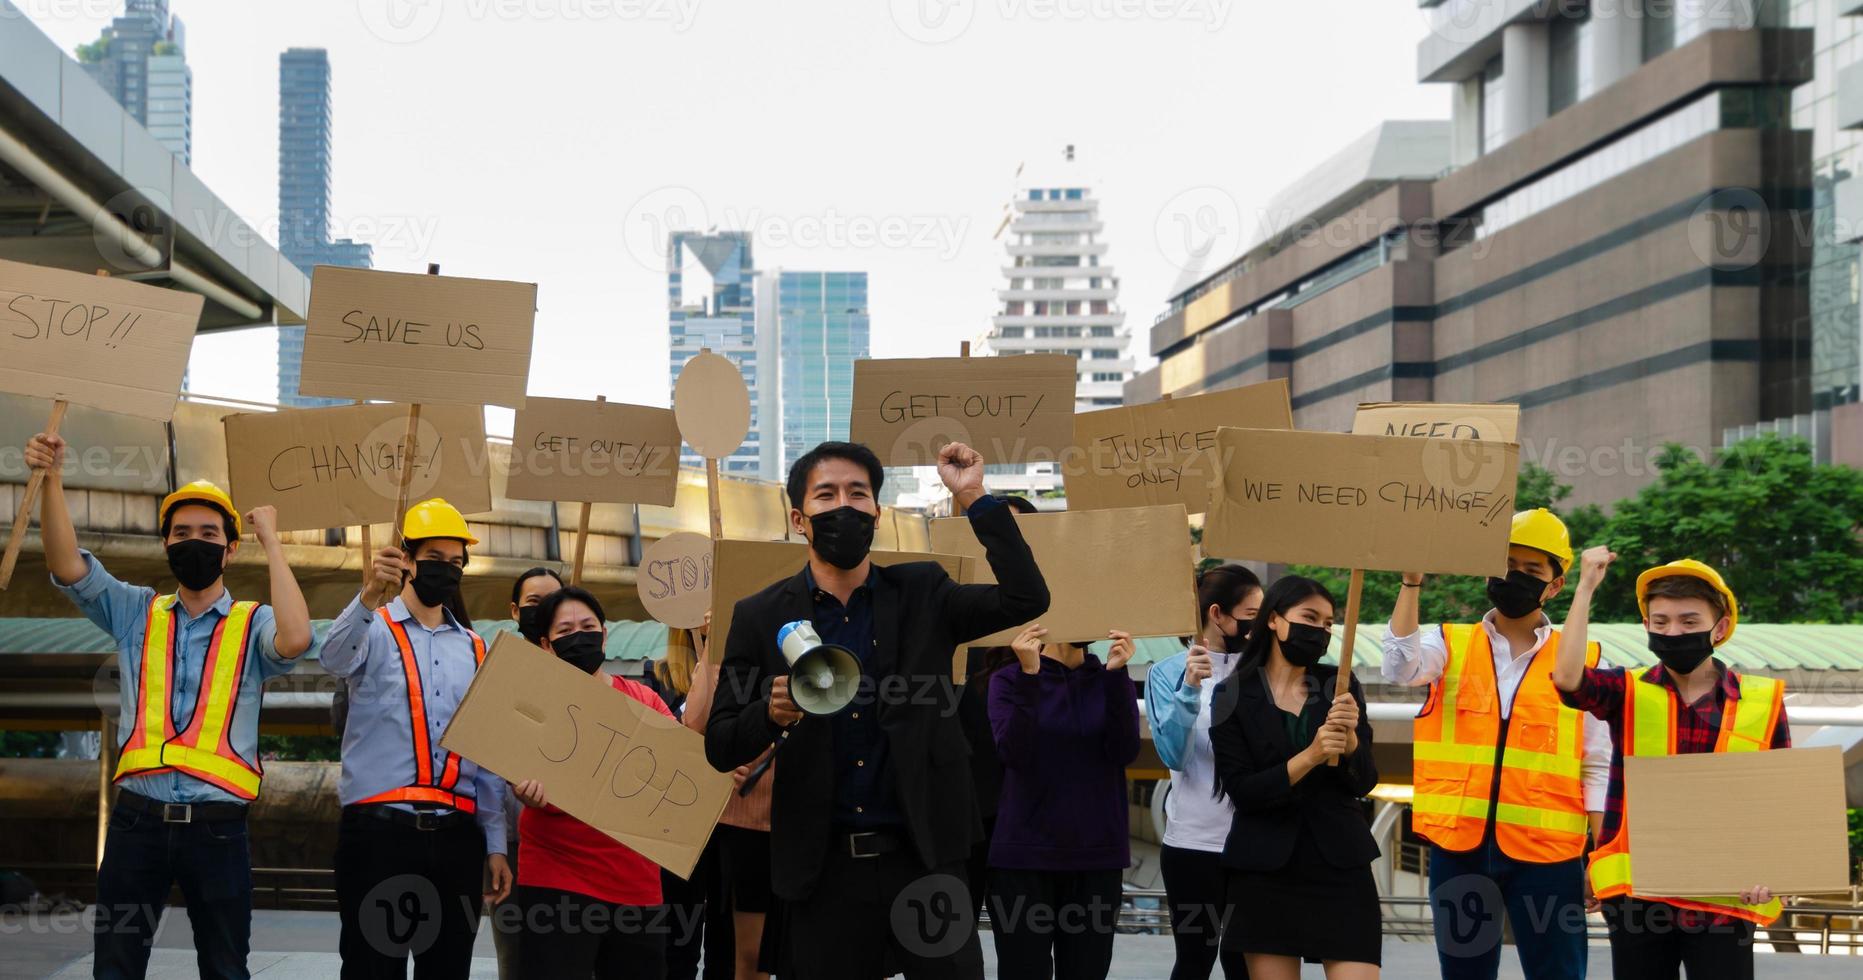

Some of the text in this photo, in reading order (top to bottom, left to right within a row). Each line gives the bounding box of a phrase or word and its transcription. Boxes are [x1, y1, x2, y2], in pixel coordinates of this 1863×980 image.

[8, 294, 142, 349] STOP!!
[342, 310, 484, 350] SAVE US
[879, 390, 1045, 428] GET OUT!
[268, 437, 442, 492] CHANGE!
[534, 431, 655, 476] GET OUT!!
[1126, 466, 1183, 491] ONLY
[1244, 478, 1510, 527] WE NEED CHANGE!!
[537, 703, 698, 817] STOP
